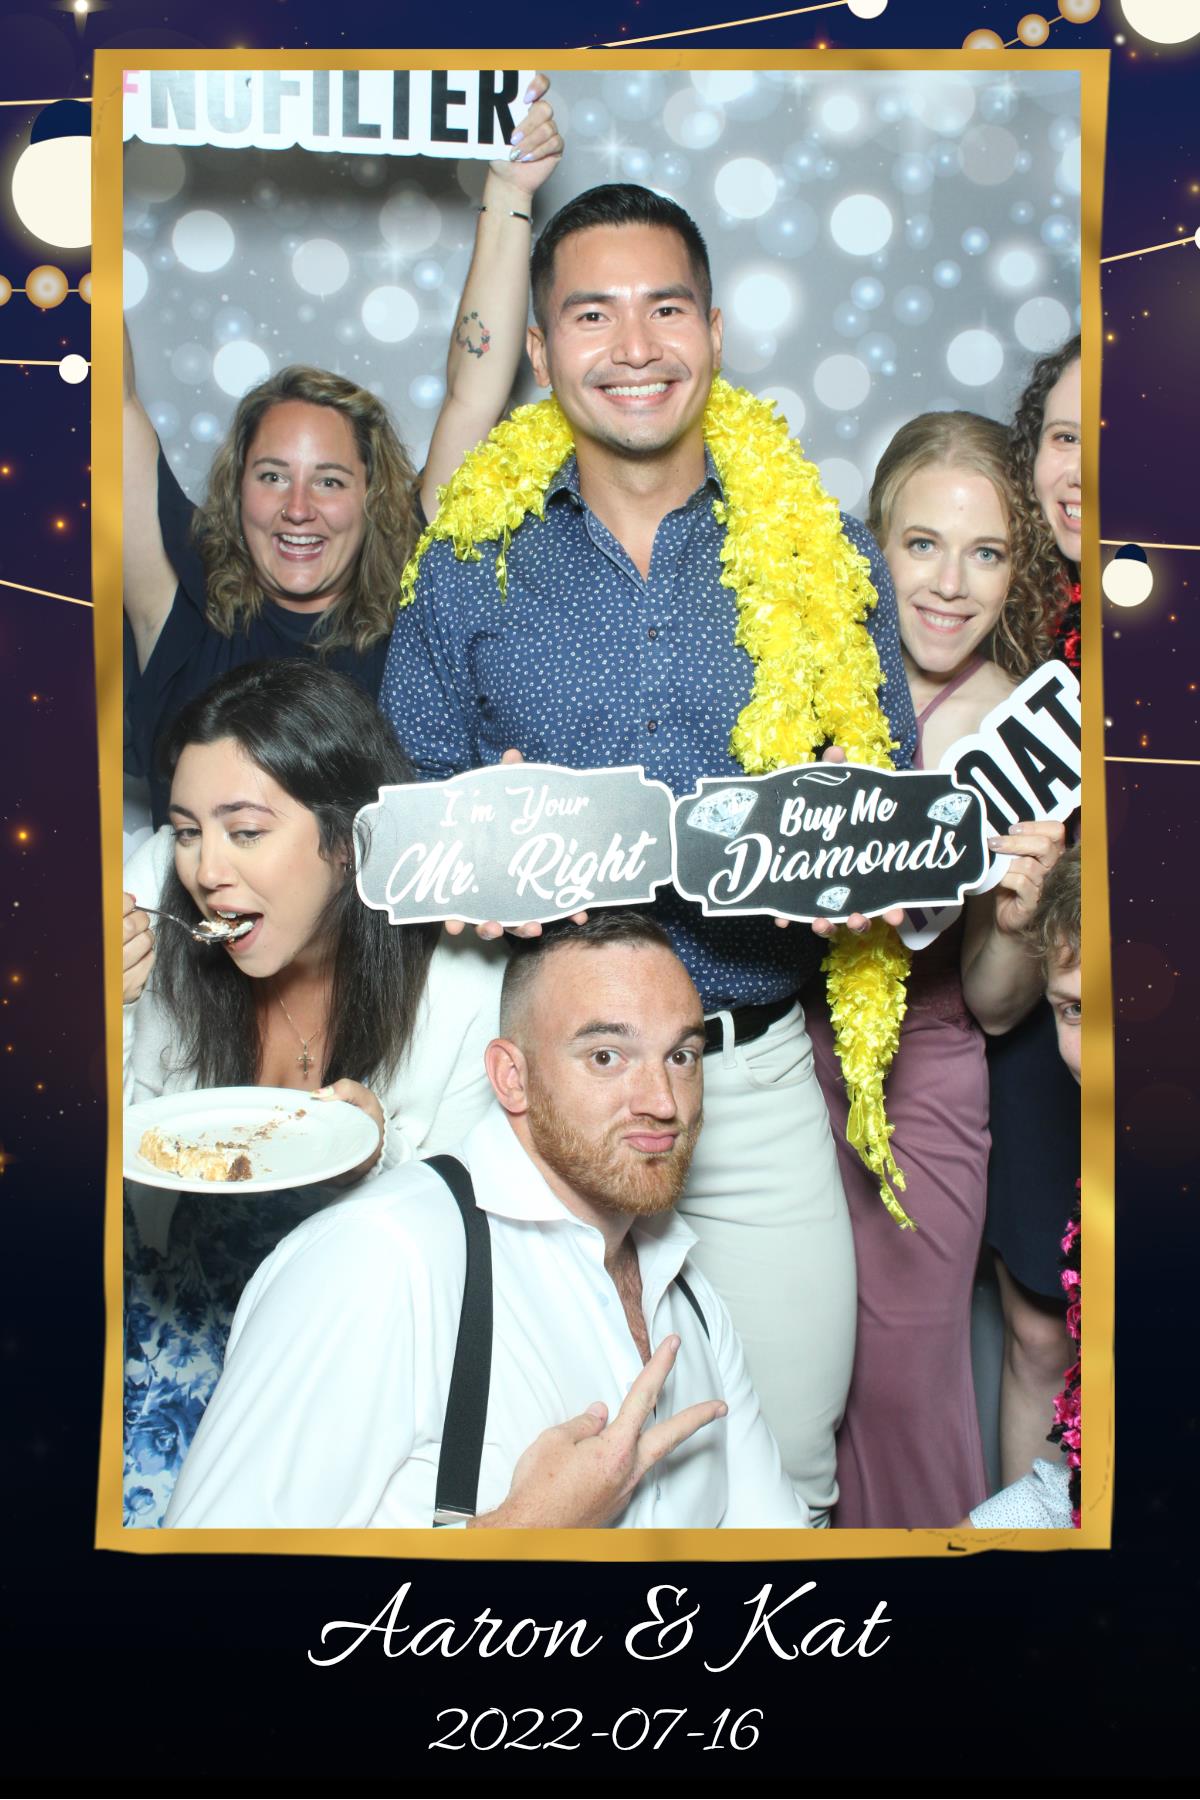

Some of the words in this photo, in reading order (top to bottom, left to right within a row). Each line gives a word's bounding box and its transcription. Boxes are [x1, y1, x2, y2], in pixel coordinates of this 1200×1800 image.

[440, 787, 496, 827] I'm
[505, 784, 590, 835] Your
[779, 796, 848, 842] Buy
[850, 786, 898, 826] Me
[385, 839, 480, 905] Mr.
[507, 830, 658, 909] Right
[708, 824, 967, 905] Diamonds
